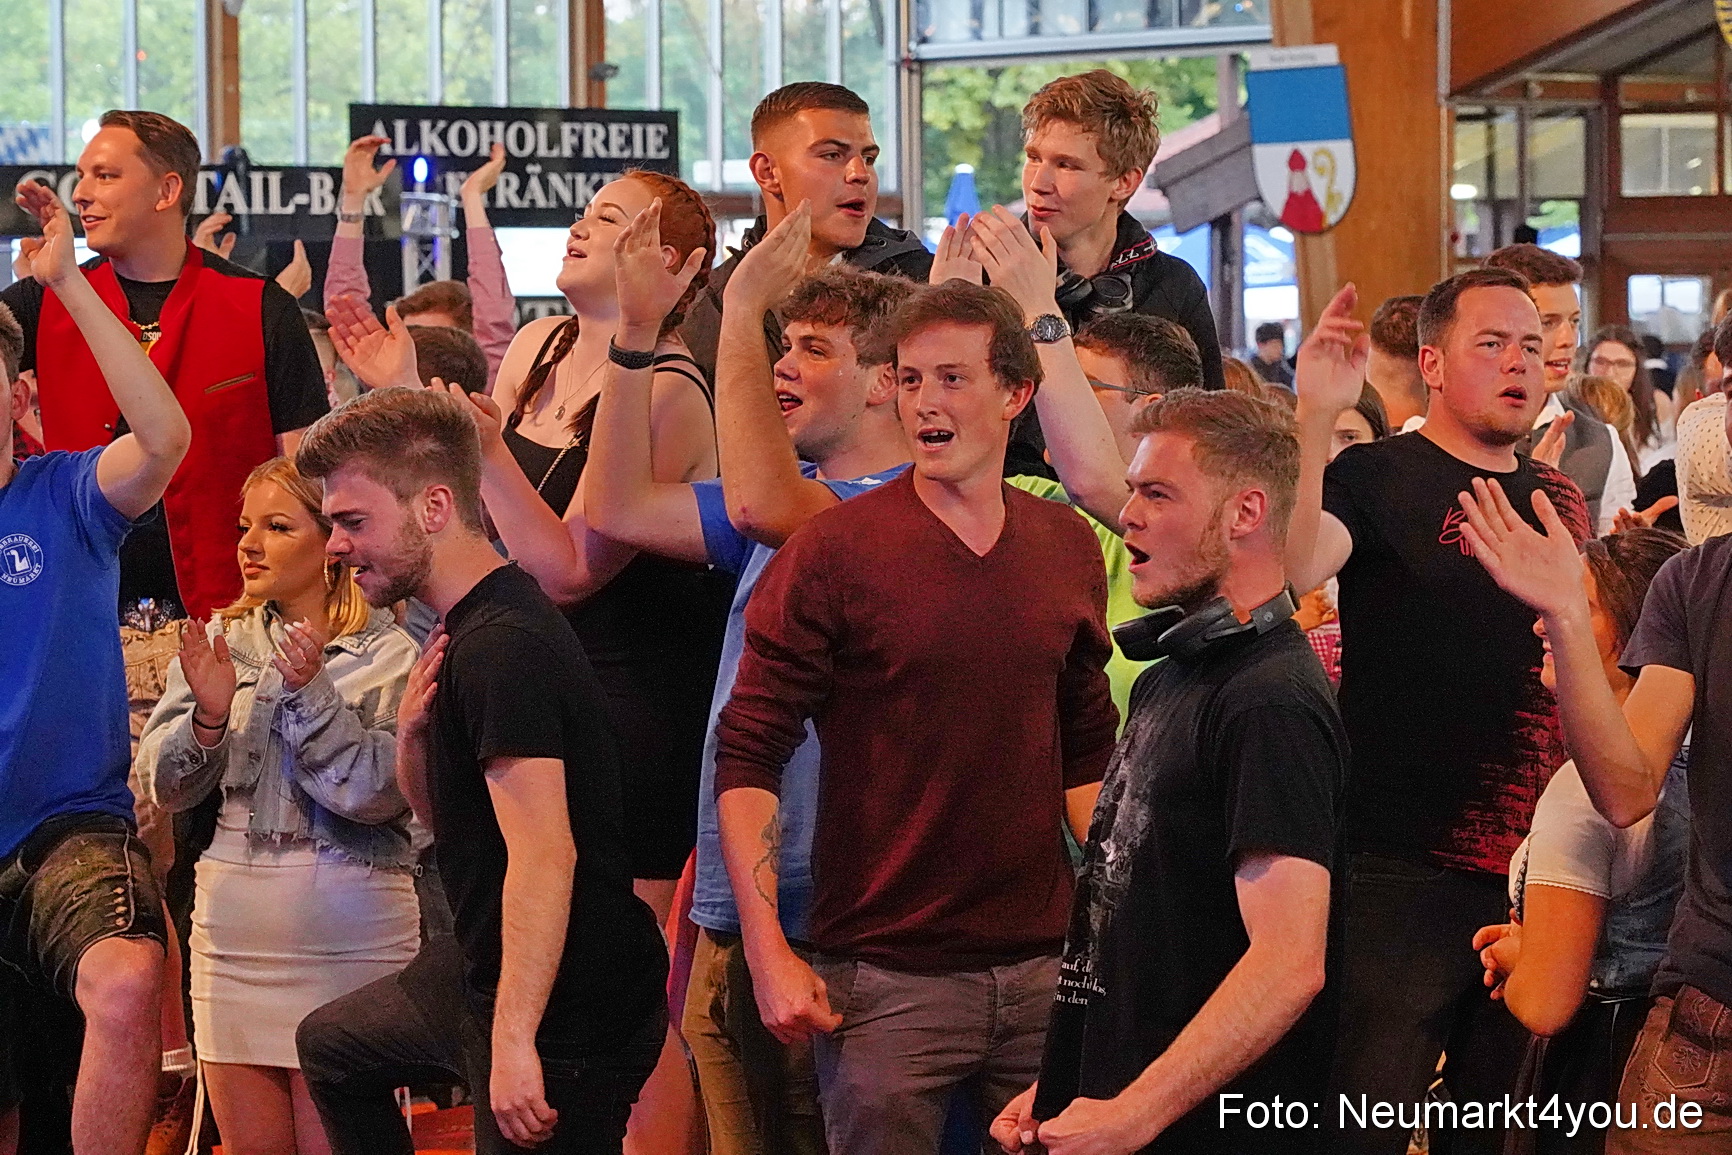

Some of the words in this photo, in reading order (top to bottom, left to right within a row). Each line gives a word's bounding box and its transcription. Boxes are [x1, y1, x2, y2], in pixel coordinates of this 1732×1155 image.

[366, 117, 670, 160] ALKOHOLFREIE
[15, 169, 387, 216] COTAIL-B
[432, 163, 624, 209] ERÄNK
[1, 562, 41, 584] NEUMARKT
[1067, 990, 1089, 1006] den
